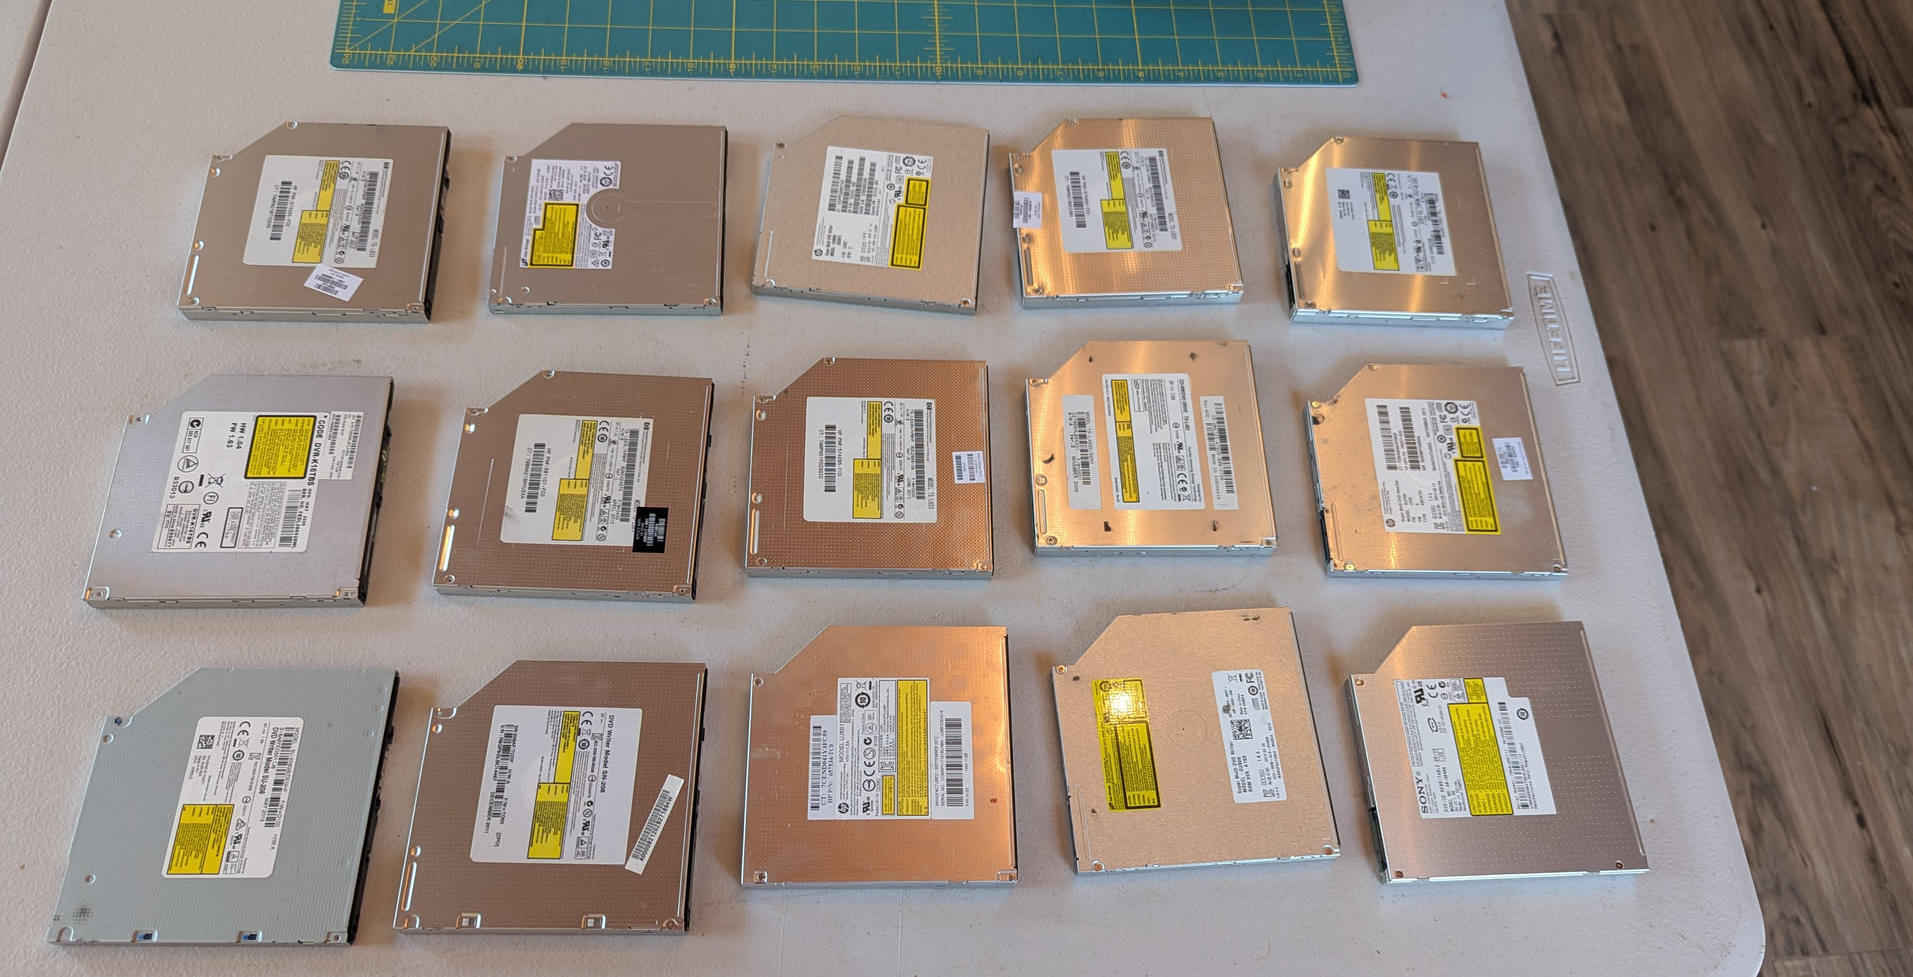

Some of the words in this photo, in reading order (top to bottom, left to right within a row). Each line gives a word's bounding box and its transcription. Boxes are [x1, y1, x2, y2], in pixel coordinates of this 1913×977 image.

[229, 422, 237, 431] FW
[238, 422, 246, 433] HW
[315, 420, 325, 438] CODE
[226, 434, 234, 447] 1.63
[235, 436, 244, 449] 1.04
[306, 442, 321, 485] DVR-K16TBS
[1176, 472, 1187, 484] CE
[194, 531, 209, 547] CE
[1244, 672, 1255, 683] FC
[1426, 684, 1438, 698] CE
[580, 711, 593, 725] CE
[236, 721, 251, 735] CE
[270, 727, 279, 738] DVD
[604, 729, 612, 747] Writer
[266, 740, 276, 755] Writer
[262, 757, 272, 773] Model
[863, 760, 875, 776] CE
[258, 774, 269, 794] SU-208
[599, 770, 607, 792] SN-208
[827, 794, 832, 803] HP
[1415, 775, 1428, 813] SONY
